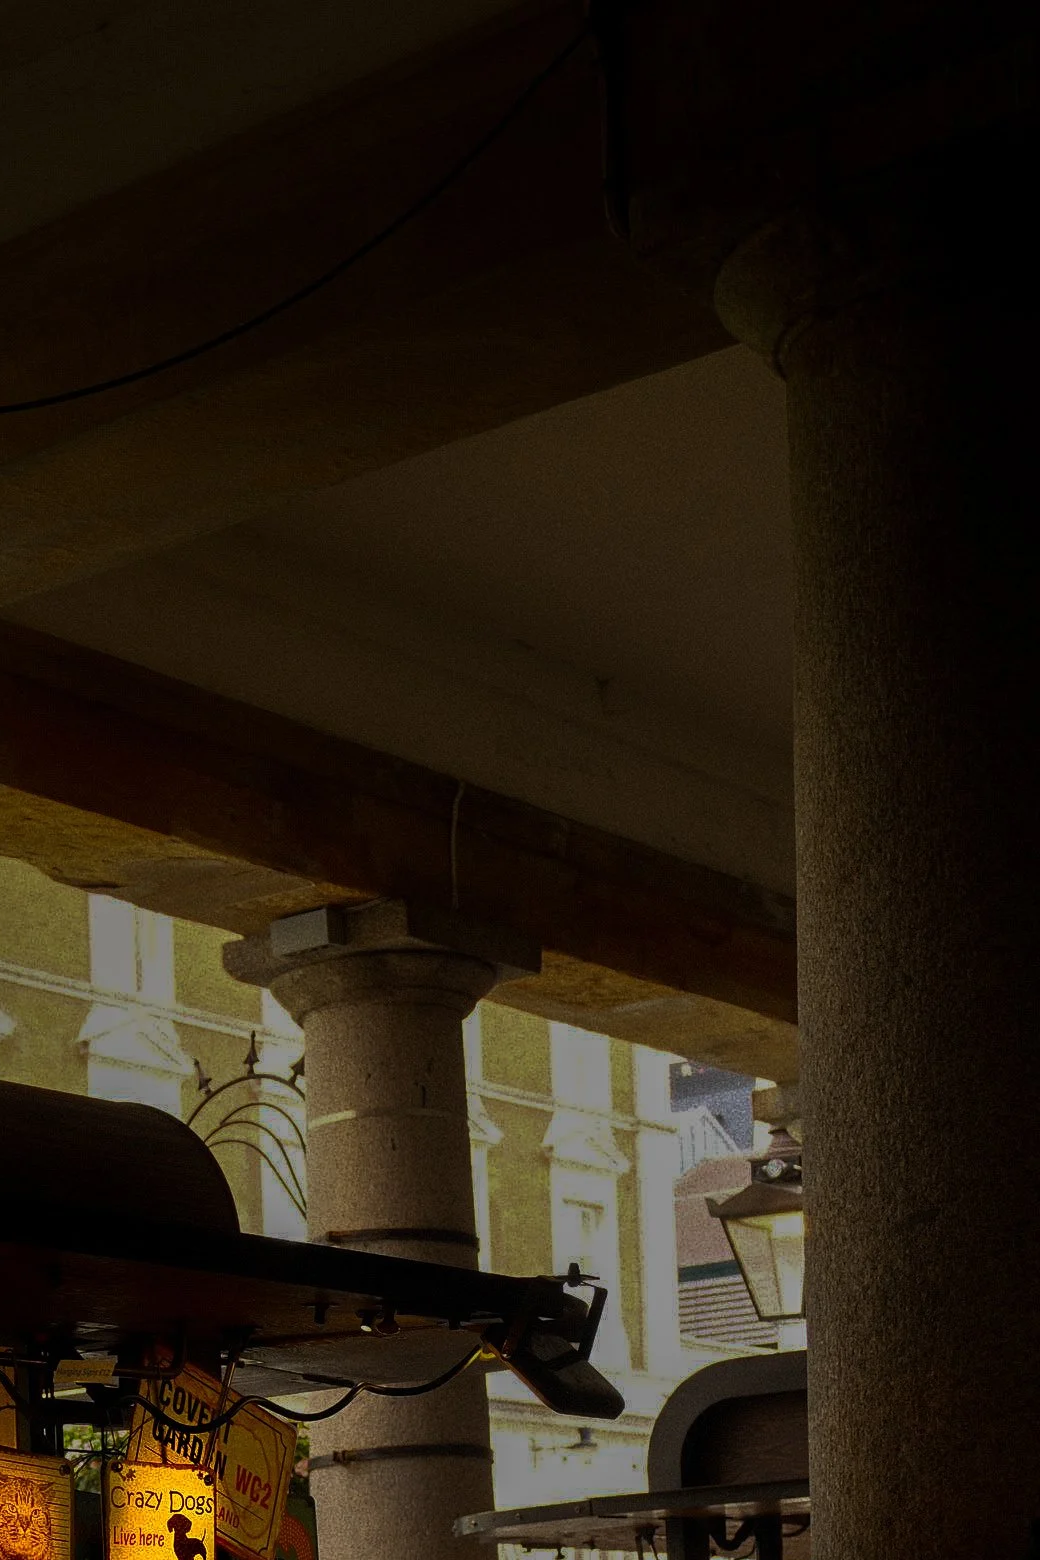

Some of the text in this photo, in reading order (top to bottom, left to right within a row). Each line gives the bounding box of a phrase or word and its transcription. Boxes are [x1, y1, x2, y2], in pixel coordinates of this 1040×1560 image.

[160, 1378, 233, 1445] COVET
[151, 1417, 227, 1481] GARDN
[110, 1486, 214, 1515] Crazy Dogs
[234, 1464, 273, 1510] WC2
[113, 1525, 165, 1548] Live here
